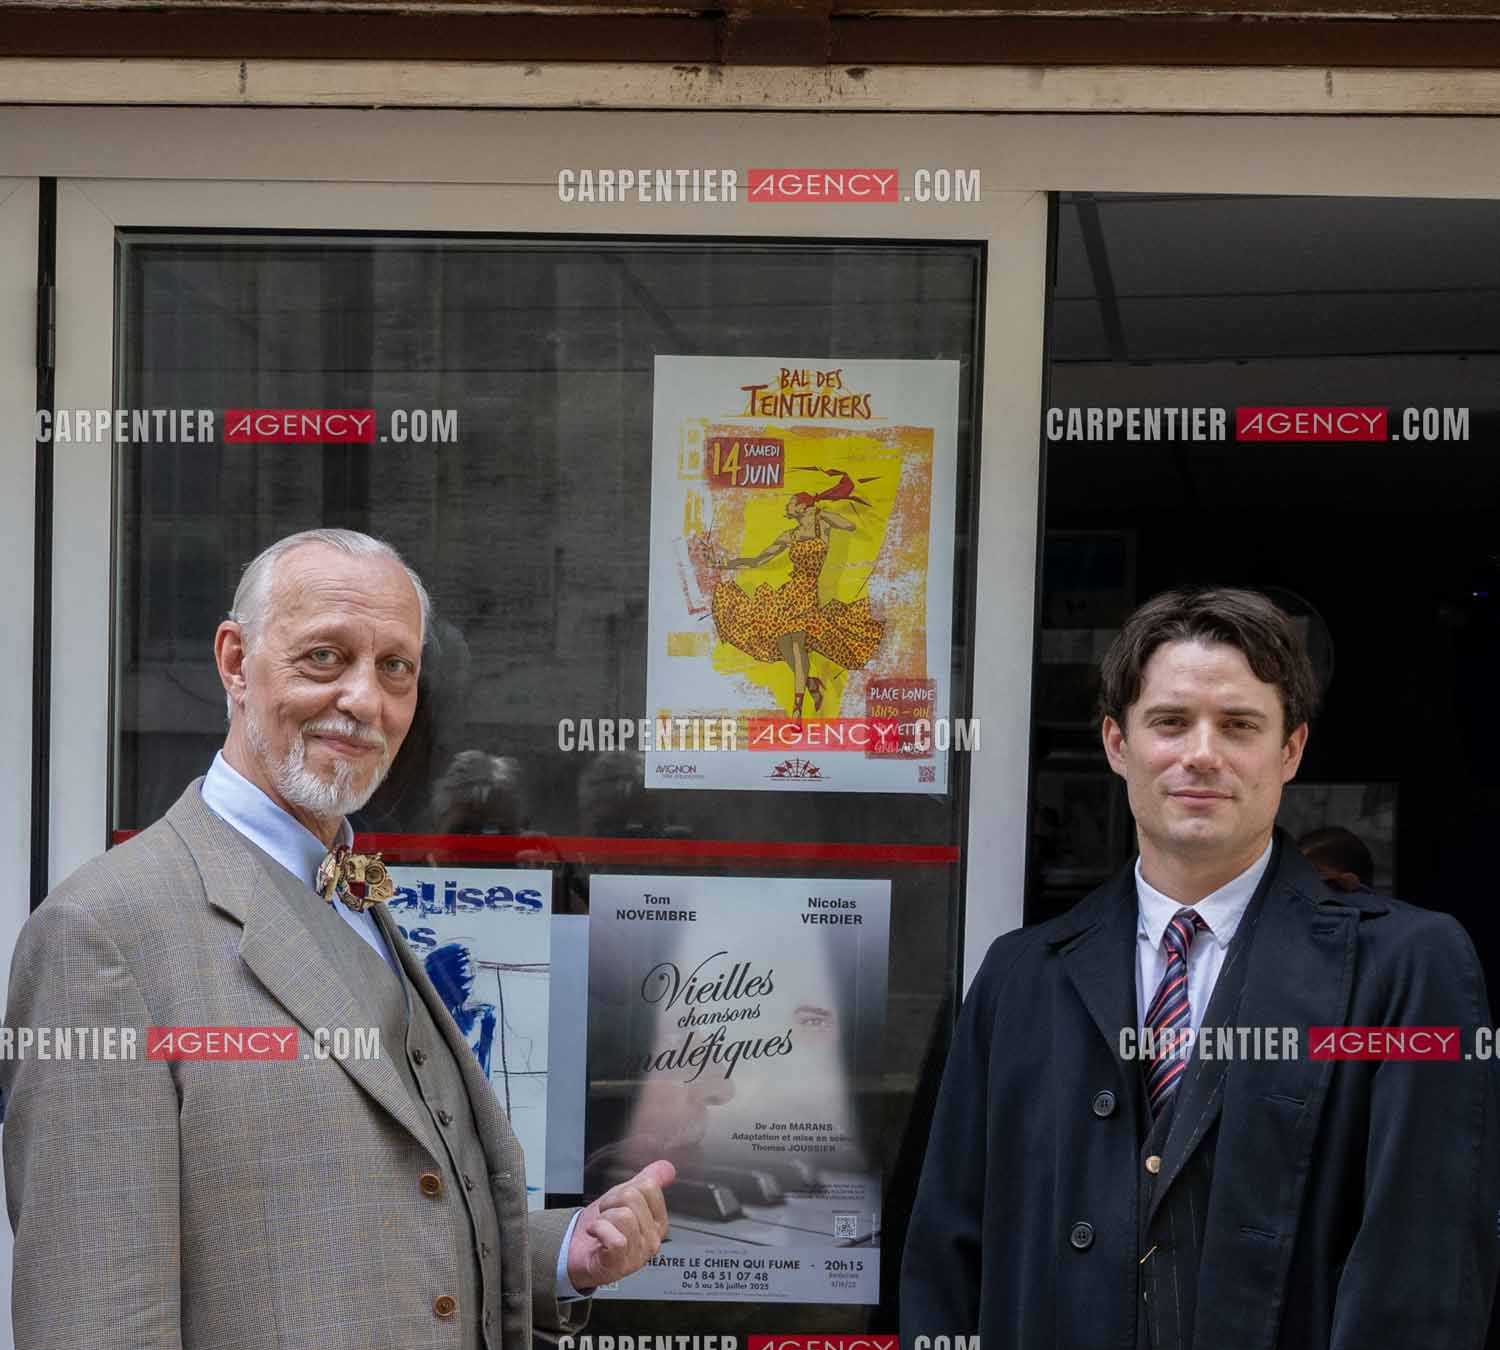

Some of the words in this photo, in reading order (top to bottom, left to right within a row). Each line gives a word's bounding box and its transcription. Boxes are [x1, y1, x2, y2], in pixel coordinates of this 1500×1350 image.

[780, 368, 809, 389] BAL
[816, 369, 843, 389] DES
[741, 384, 871, 420] TEINTURIERS
[744, 443, 780, 457] SAMEDI
[713, 441, 741, 486] 14
[740, 463, 780, 486] JUIN
[871, 688, 899, 701] PLACE
[656, 764, 697, 775] AVIGNON
[388, 880, 544, 918] alises
[643, 894, 671, 905] Tom
[807, 897, 857, 909] Nicolas
[616, 909, 697, 922] NOVEMBRE
[801, 913, 863, 925] VERDIER
[641, 951, 774, 1012] Vieilles
[677, 1003, 761, 1028] chansons
[789, 1122, 833, 1132] MARANS
[731, 1132, 780, 1143] Adaptation
[689, 1257, 701, 1268] LE
[704, 1258, 739, 1268] CHIEN
[743, 1259, 765, 1269] QUI
[768, 1260, 801, 1270] FUME
[824, 1260, 863, 1271] 20h15
[683, 1271, 697, 1280] 04
[701, 1271, 715, 1280] 84
[736, 1271, 752, 1281] 07
[754, 1272, 769, 1281] 48
